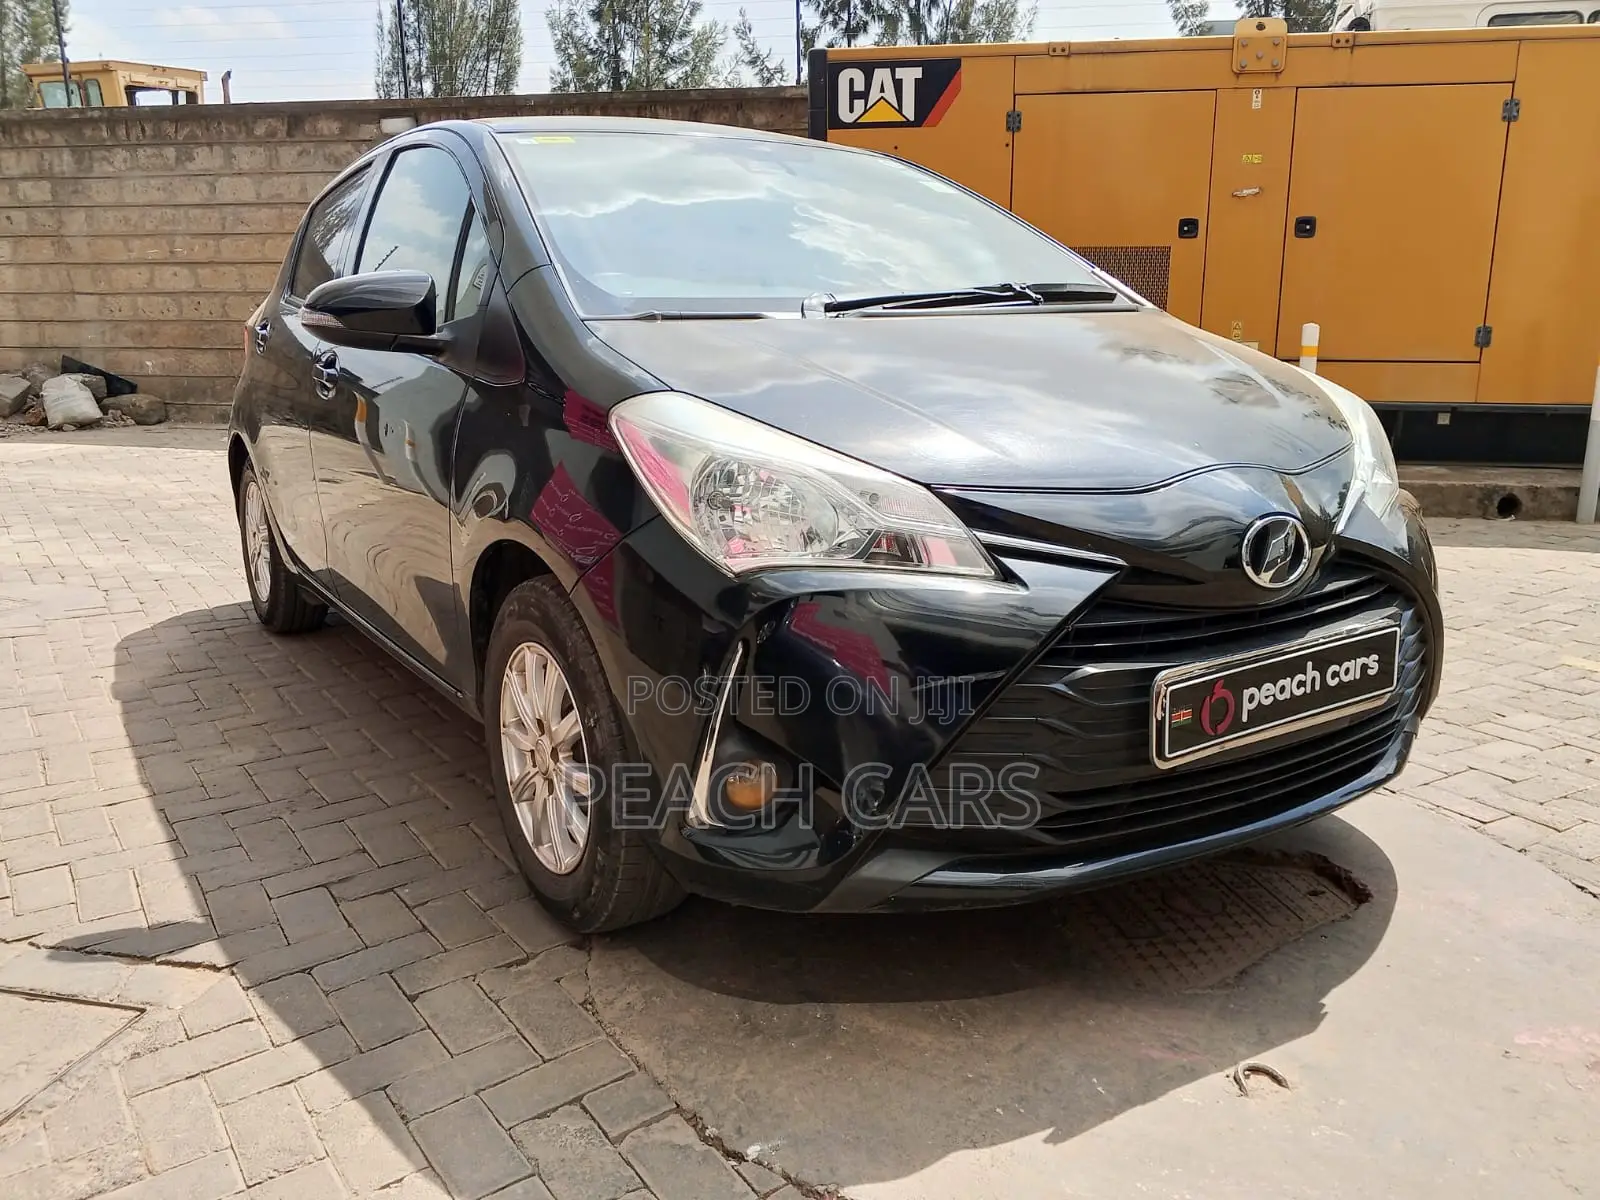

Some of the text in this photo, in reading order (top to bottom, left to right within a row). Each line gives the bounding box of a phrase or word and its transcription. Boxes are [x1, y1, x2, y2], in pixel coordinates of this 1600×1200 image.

[838, 67, 923, 123] CAT
[1242, 653, 1380, 722] peach cars
